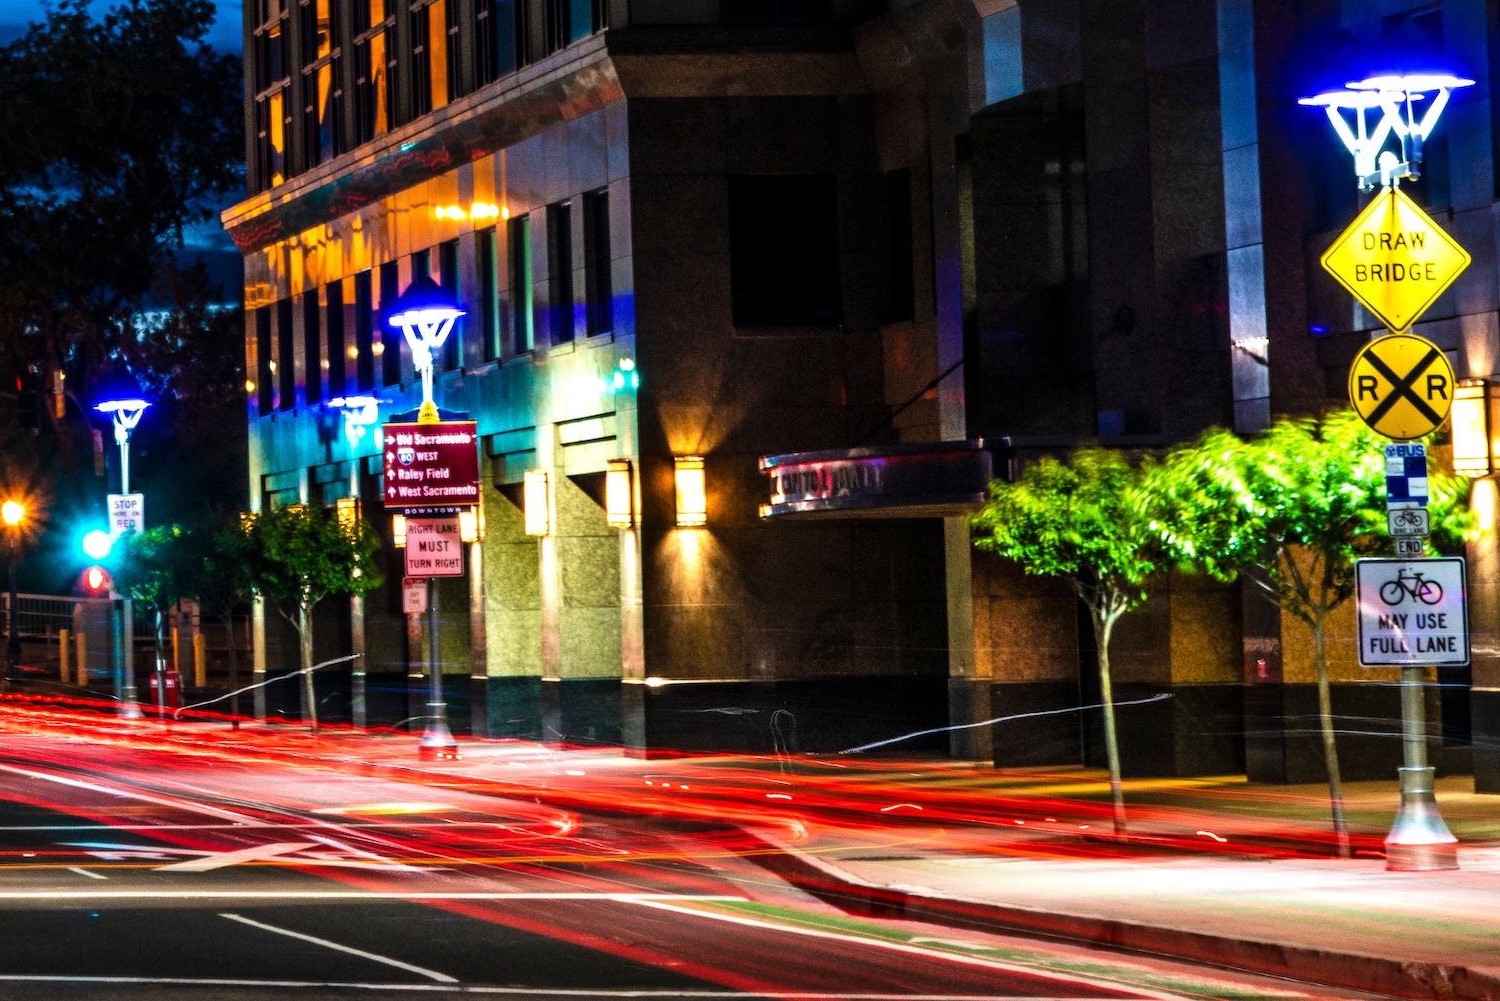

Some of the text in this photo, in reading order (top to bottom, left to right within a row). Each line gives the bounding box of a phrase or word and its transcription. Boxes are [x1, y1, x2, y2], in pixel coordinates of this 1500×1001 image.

[1363, 232, 1426, 251] DRAW
[1355, 263, 1437, 282] BRIDGE
[1358, 374, 1448, 401] R R
[396, 431, 471, 446] Old Sacramento
[401, 451, 438, 462] 80 WEST
[1396, 445, 1425, 457] BUS
[398, 467, 450, 481] Raley Field
[398, 484, 477, 497] West Sacramento
[114, 500, 137, 509] STOP
[404, 506, 461, 515] DOWNTOWN
[117, 519, 135, 527] RED
[408, 524, 458, 534] RIGHT LANE
[419, 541, 449, 552] MUST
[1399, 541, 1420, 553] END
[409, 558, 460, 569] TURN RIGHT
[1379, 613, 1447, 630] MAY USE
[1370, 636, 1457, 653] FULL LANE
